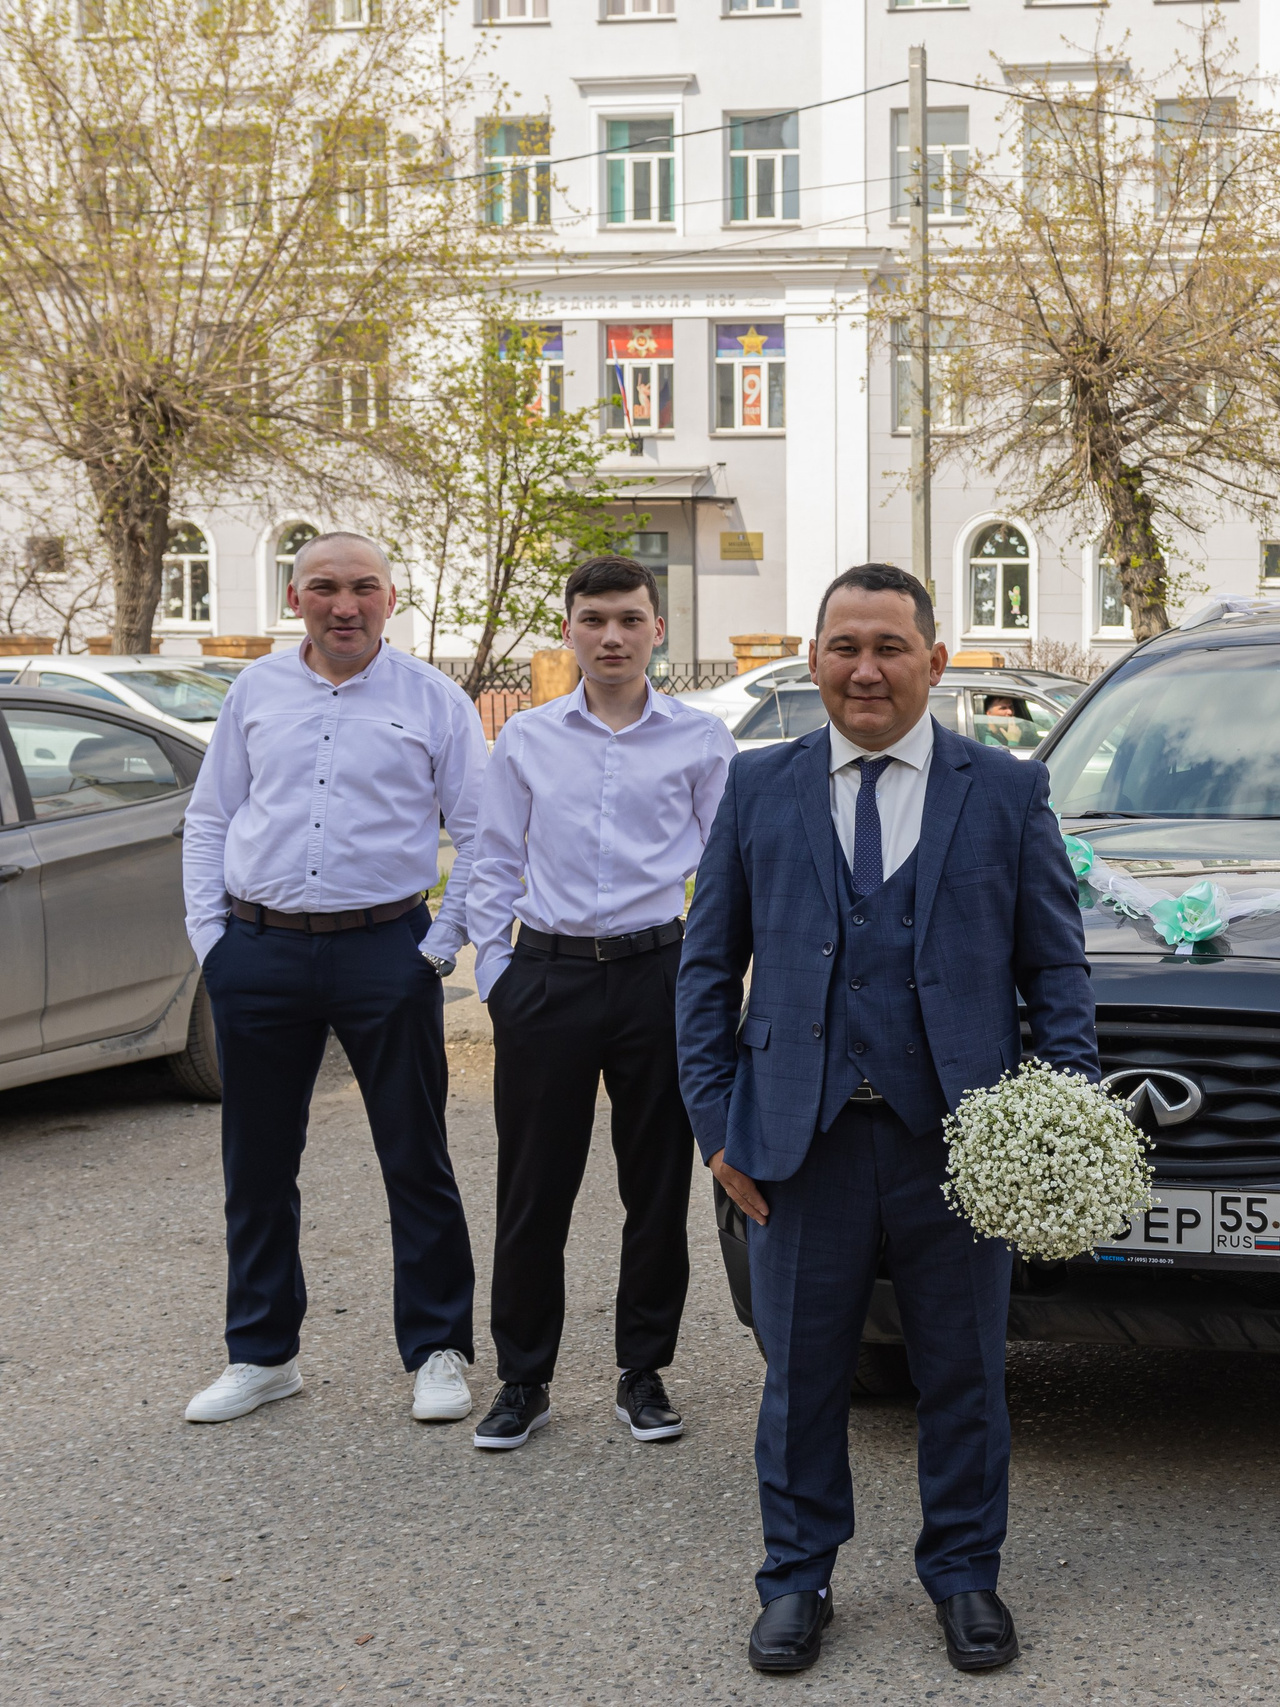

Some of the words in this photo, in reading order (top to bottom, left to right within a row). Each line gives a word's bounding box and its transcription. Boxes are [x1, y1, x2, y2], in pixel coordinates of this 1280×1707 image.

[631, 294, 692, 309] ШКОЛА
[743, 373, 761, 405] 9
[1220, 1196, 1268, 1233] 55
[1217, 1235, 1253, 1248] RUS
